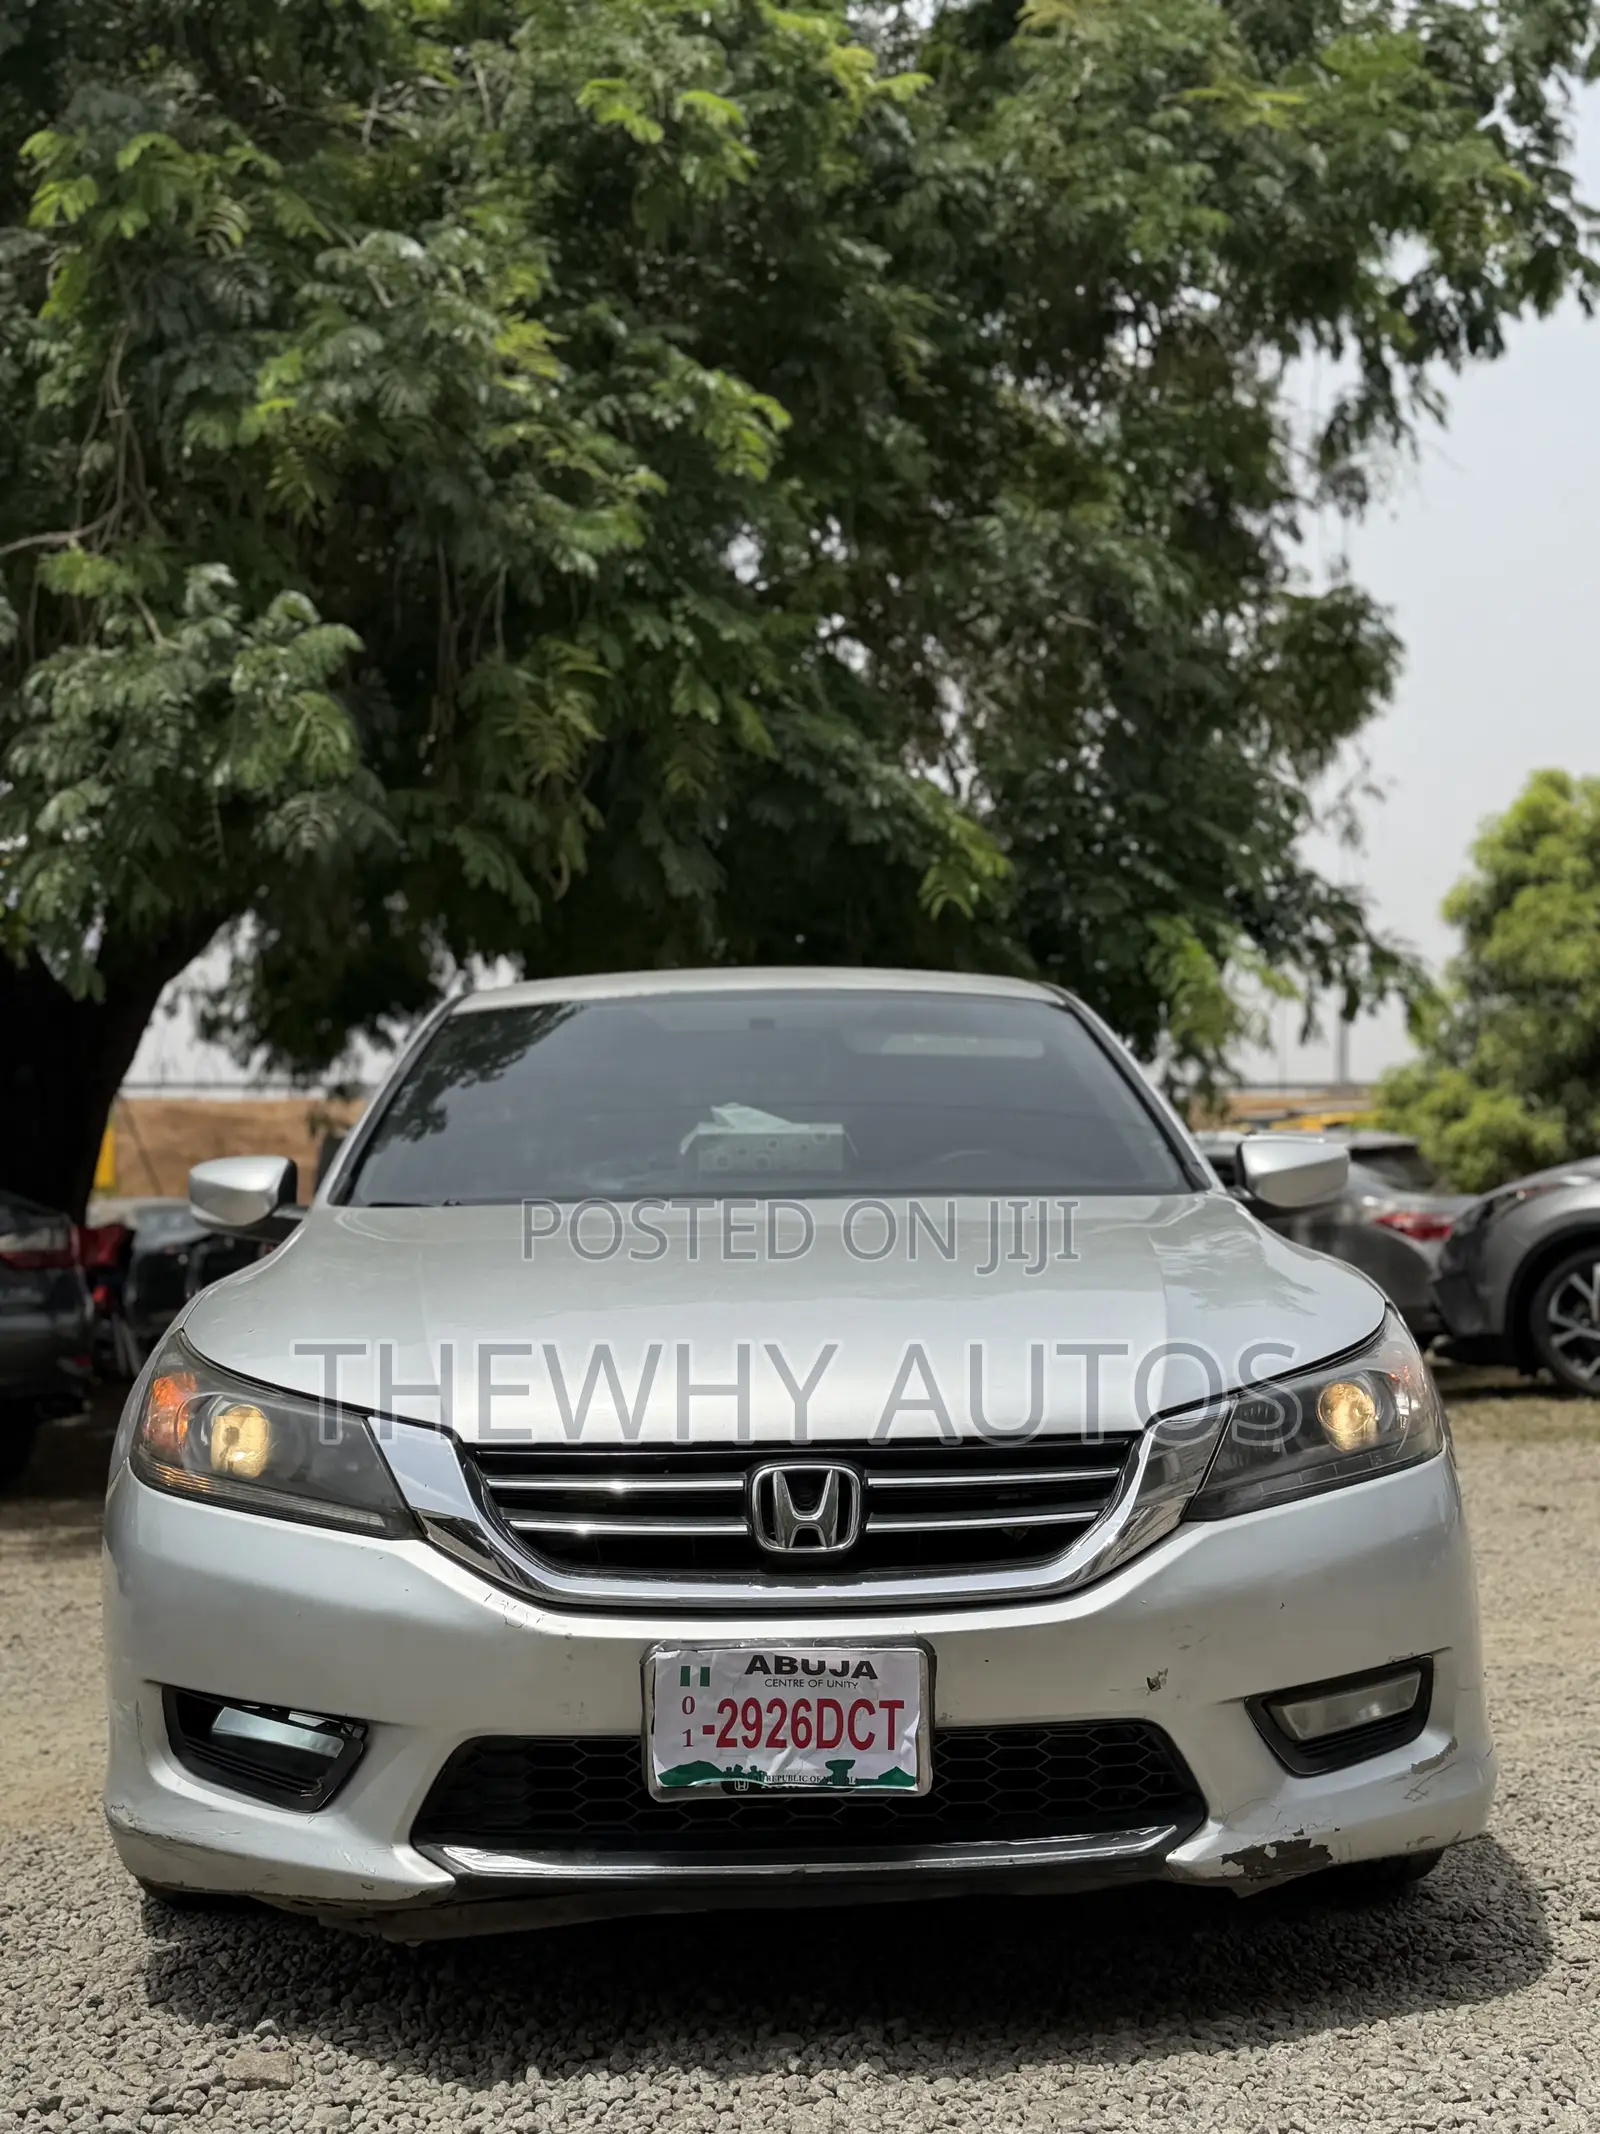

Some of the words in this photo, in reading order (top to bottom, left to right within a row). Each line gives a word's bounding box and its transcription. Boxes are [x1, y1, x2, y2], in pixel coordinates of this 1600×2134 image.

[744, 1654, 878, 1680] ABUJA
[764, 1678, 805, 1688] CENTRE
[807, 1679, 824, 1688] OF
[826, 1680, 859, 1689] UNITY
[765, 1774, 808, 1783] REPUBLIC
